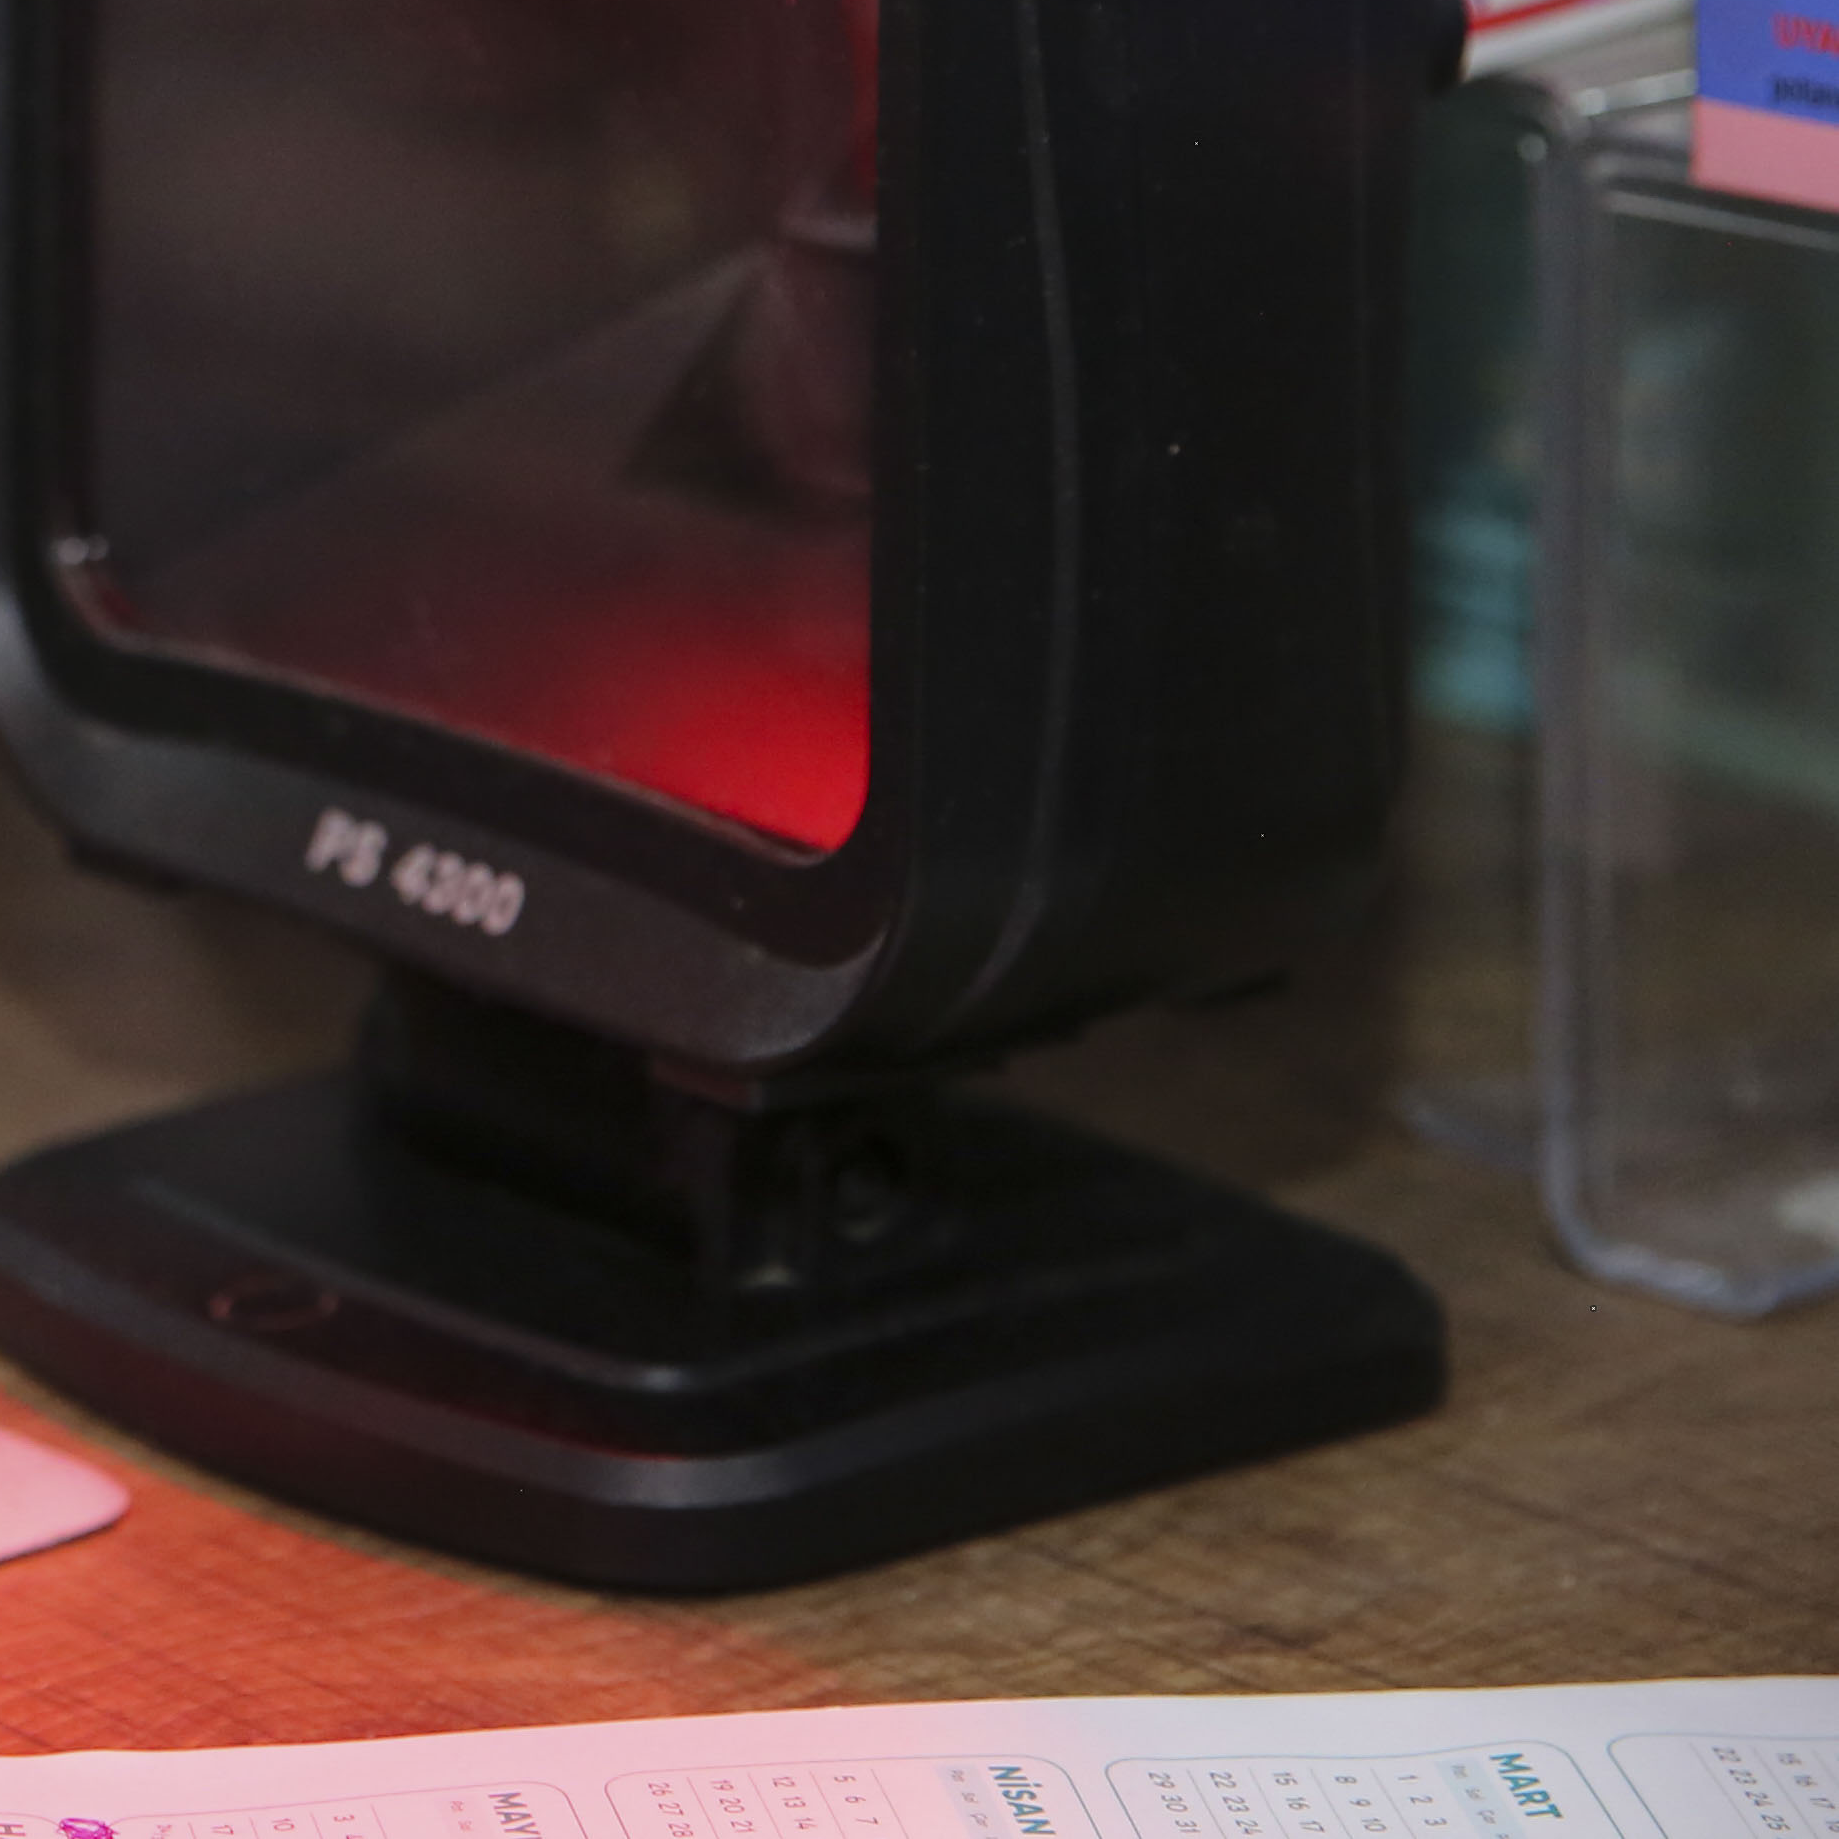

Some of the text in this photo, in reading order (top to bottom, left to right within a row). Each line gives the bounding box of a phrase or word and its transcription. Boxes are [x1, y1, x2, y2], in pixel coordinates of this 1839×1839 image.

[488, 1791, 543, 1839] MAY
[833, 1774, 879, 1826] 5 6 7
[988, 1765, 1057, 1836] NİSAN
[1148, 1771, 1202, 1834] 29 30 31
[1209, 1771, 1264, 1836] 22 23 24
[1272, 1771, 1325, 1834] 15 16 17
[1334, 1775, 1388, 1833] 8 9 10
[1409, 1795, 1434, 1805] 2
[1423, 1817, 1448, 1827] 3
[1488, 1752, 1564, 1820] MART
